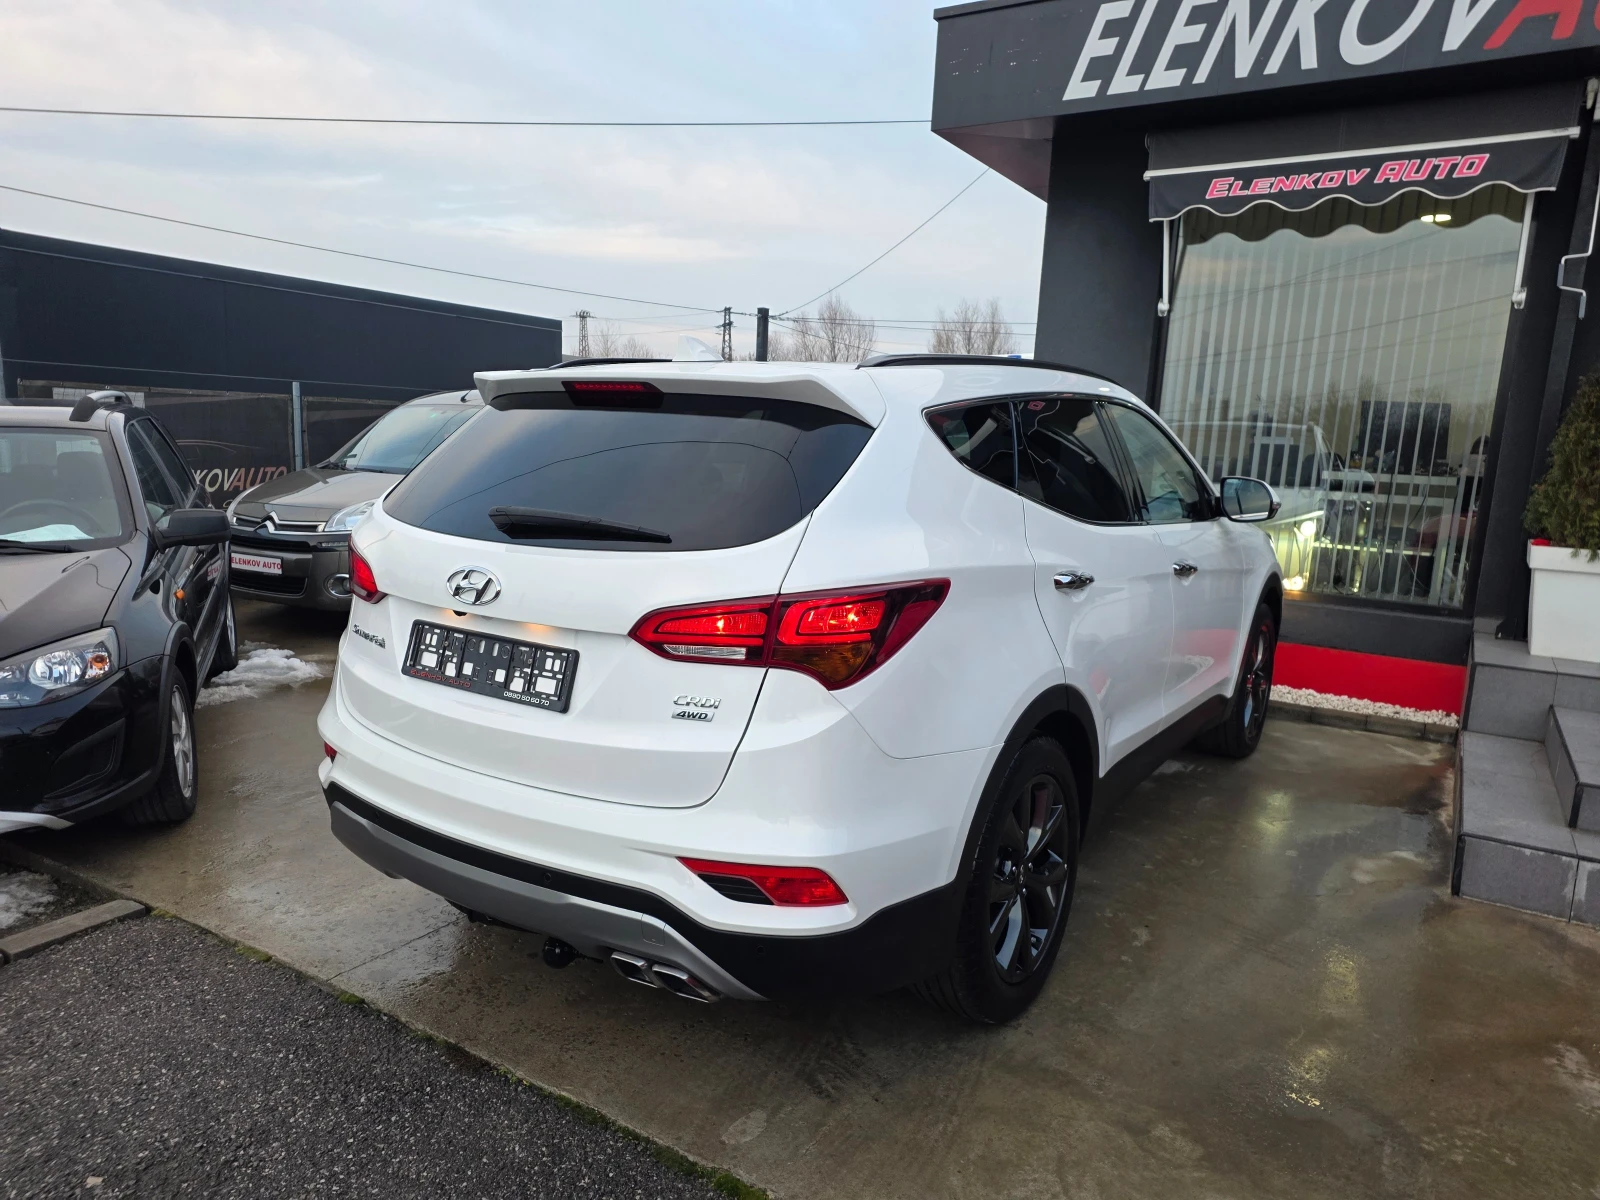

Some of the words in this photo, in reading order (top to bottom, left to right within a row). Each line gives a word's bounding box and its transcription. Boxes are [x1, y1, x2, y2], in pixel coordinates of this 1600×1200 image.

[1374, 153, 1490, 184] AUTO
[230, 556, 261, 568] ELENKOV
[262, 561, 283, 570] AUTO
[448, 678, 471, 688] AUTO
[673, 694, 722, 710] CRDi
[675, 710, 709, 720] 4WD
